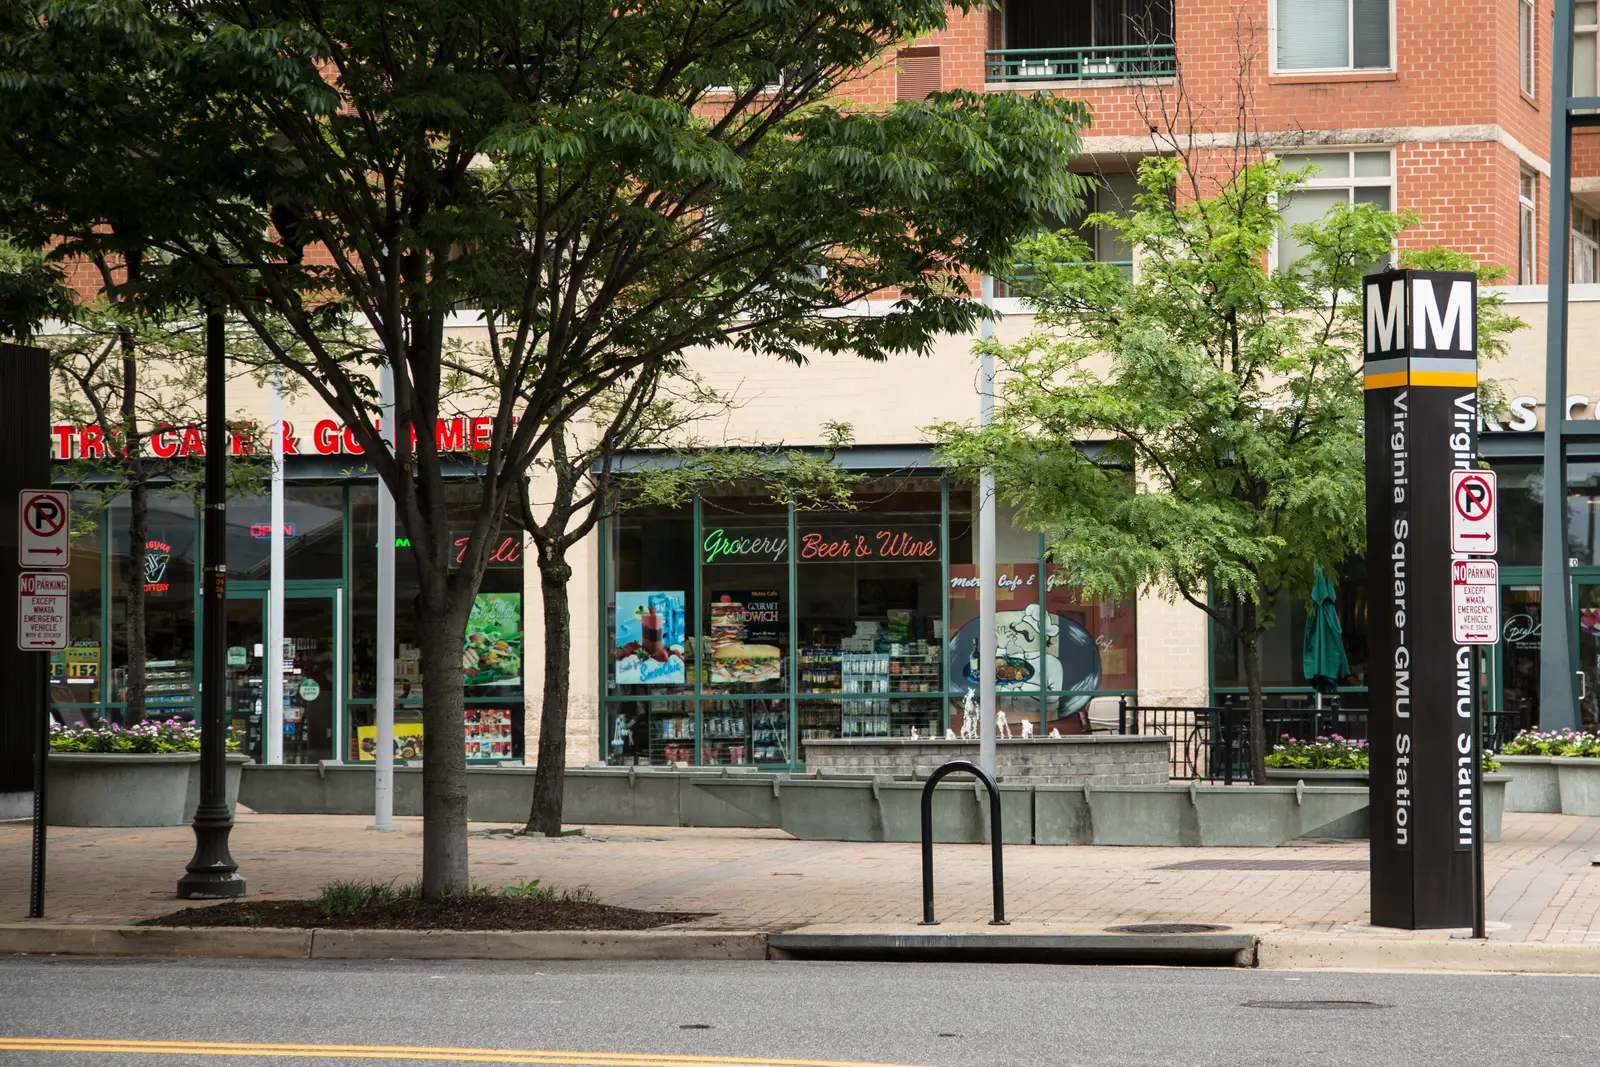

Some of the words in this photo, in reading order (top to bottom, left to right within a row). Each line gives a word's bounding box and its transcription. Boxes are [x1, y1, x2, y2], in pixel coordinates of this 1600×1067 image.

[1367, 279, 1405, 354] M
[1413, 279, 1472, 351] M
[1566, 394, 1600, 420] C
[150, 420, 256, 458] CAE
[1391, 391, 1408, 504] Virginia
[250, 525, 293, 537] OPN
[453, 536, 521, 564] Dli
[703, 529, 788, 562] Grocery
[801, 533, 852, 559] Beer
[855, 535, 873, 557] &
[876, 531, 937, 557] Wine
[1454, 565, 1466, 582] NO
[1468, 568, 1495, 579] PARKING
[21, 577, 35, 593] NO
[36, 580, 67, 591] PARKING
[951, 577, 981, 588] Metr
[998, 574, 1023, 592] Cafe
[1464, 587, 1486, 595] EXCEPT
[31, 597, 56, 605] EXCEPT
[747, 603, 779, 611] GOURMET
[1466, 596, 1485, 605] WMATA
[33, 606, 55, 614] WMATA
[725, 611, 779, 622] SANDWICH
[1458, 606, 1493, 614] EMERGENCY
[24, 615, 63, 623] EMERGENCY
[1392, 519, 1410, 718] Square-GMU
[1464, 615, 1488, 624] VEHICLE
[50, 664, 64, 676] 6
[71, 664, 98, 677] 152
[1396, 733, 1411, 845] Station
